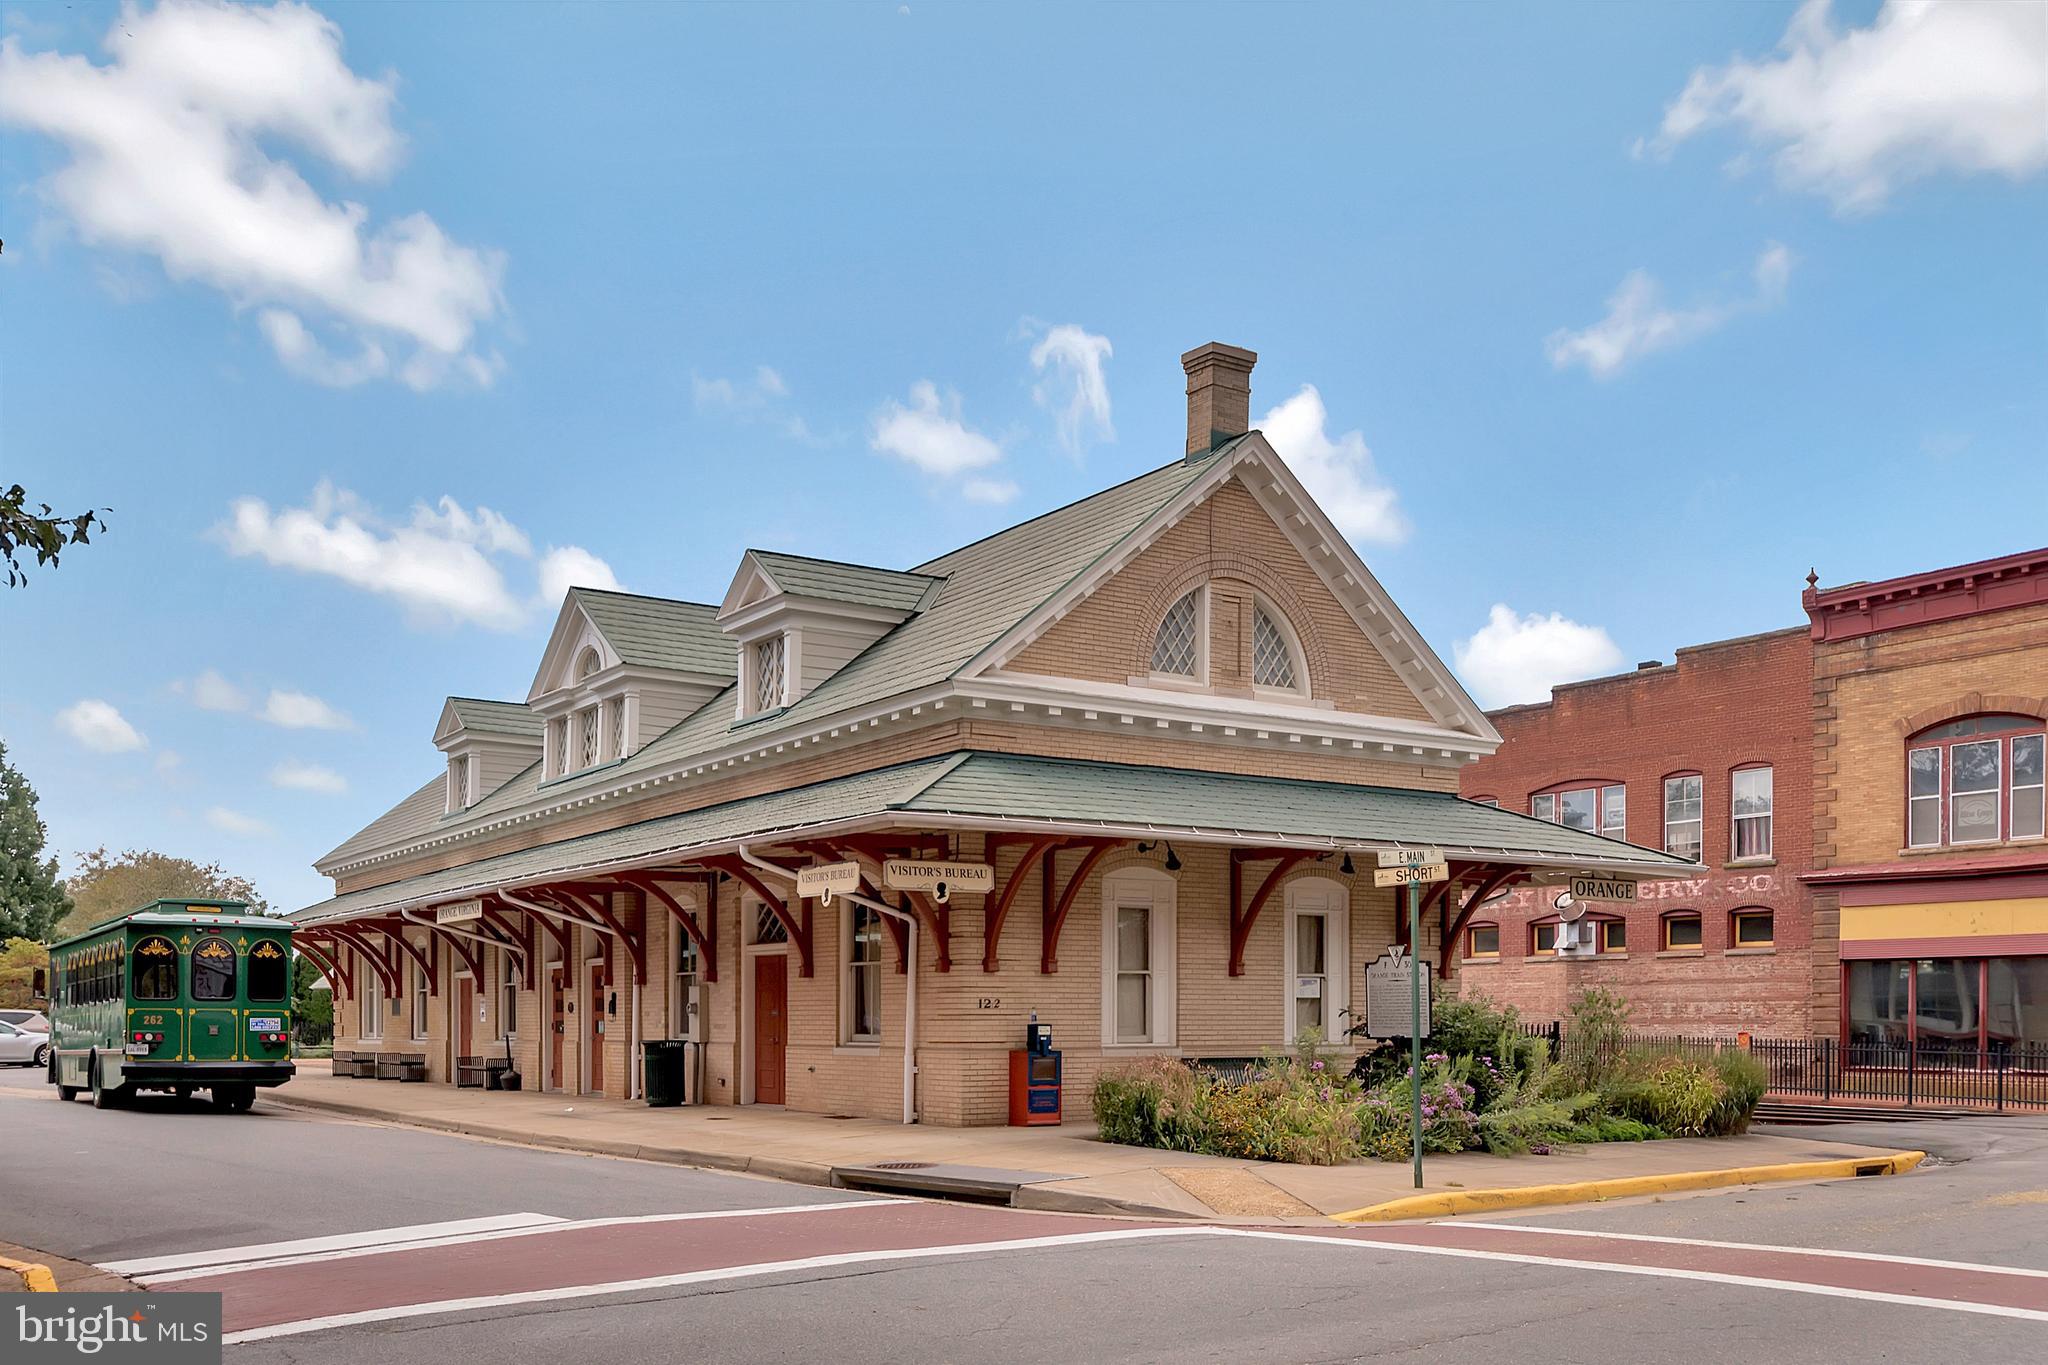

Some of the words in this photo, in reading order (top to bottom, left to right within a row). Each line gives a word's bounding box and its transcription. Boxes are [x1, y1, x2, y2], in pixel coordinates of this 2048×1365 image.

[801, 870, 829, 883] VISITOR'S
[830, 867, 856, 881] BUREAU
[890, 864, 942, 877] VISITOR'S
[945, 868, 988, 880] BUREAU
[1396, 867, 1433, 882] SHORT
[1574, 880, 1633, 899] ORANGE
[978, 998, 1001, 1009] 122
[143, 1015, 163, 1025] 262
